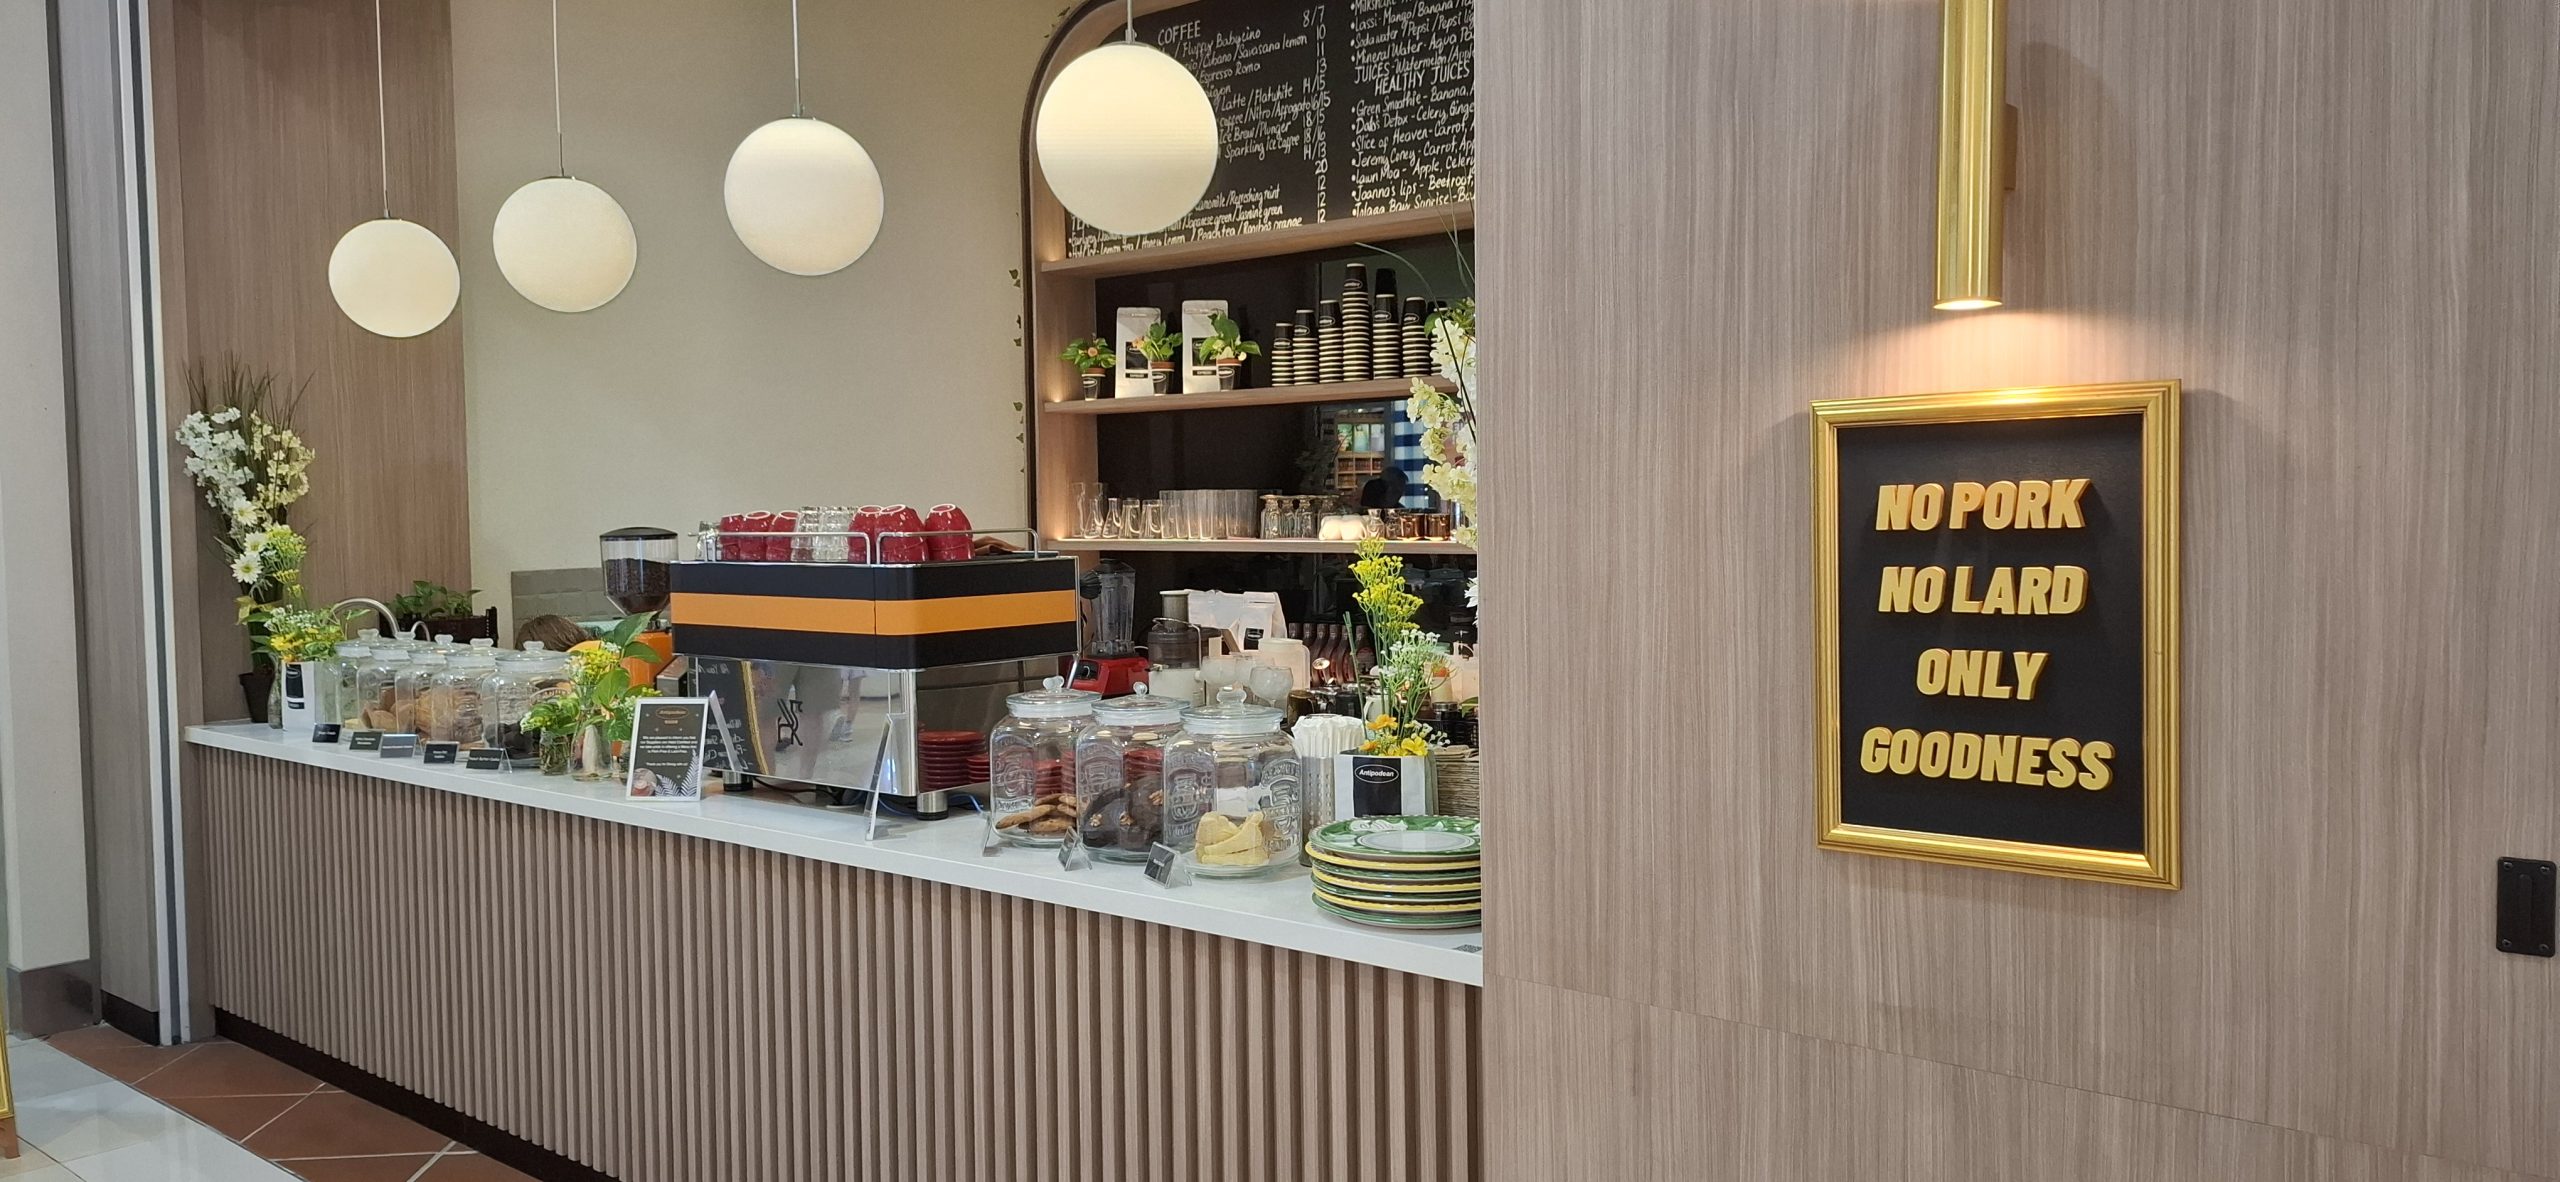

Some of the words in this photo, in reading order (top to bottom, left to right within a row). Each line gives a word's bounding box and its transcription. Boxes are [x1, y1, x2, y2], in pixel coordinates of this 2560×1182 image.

[1157, 20, 1201, 46] COFFEE
[1316, 23, 1326, 41] 10
[1429, 32, 1457, 54] Aqua
[1315, 57, 1328, 75] 13
[1354, 62, 1391, 84] JUICES
[1374, 69, 1425, 96] HEALTHY
[1431, 60, 1470, 85] JUICES
[1356, 100, 1381, 117] Green
[1382, 90, 1421, 112] Smoothie
[1224, 138, 1266, 164] Sparkling
[1354, 133, 1376, 151] Slice
[1379, 136, 1390, 154] of
[1392, 127, 1429, 145] Heaven
[1314, 158, 1328, 175] 20
[1354, 150, 1391, 170] Jeremy
[1317, 174, 1327, 191] 12
[1379, 166, 1400, 182] Moa
[1317, 191, 1327, 208] 12
[1317, 208, 1327, 224] 12
[1875, 482, 1944, 532] NO
[1948, 478, 2092, 531] PORK
[1878, 565, 1947, 615] NO
[1950, 564, 2089, 616] LARD
[1916, 648, 2050, 702] ONLY
[1860, 726, 2117, 792] GOODNESS
[1359, 768, 1394, 778] Antipodean
